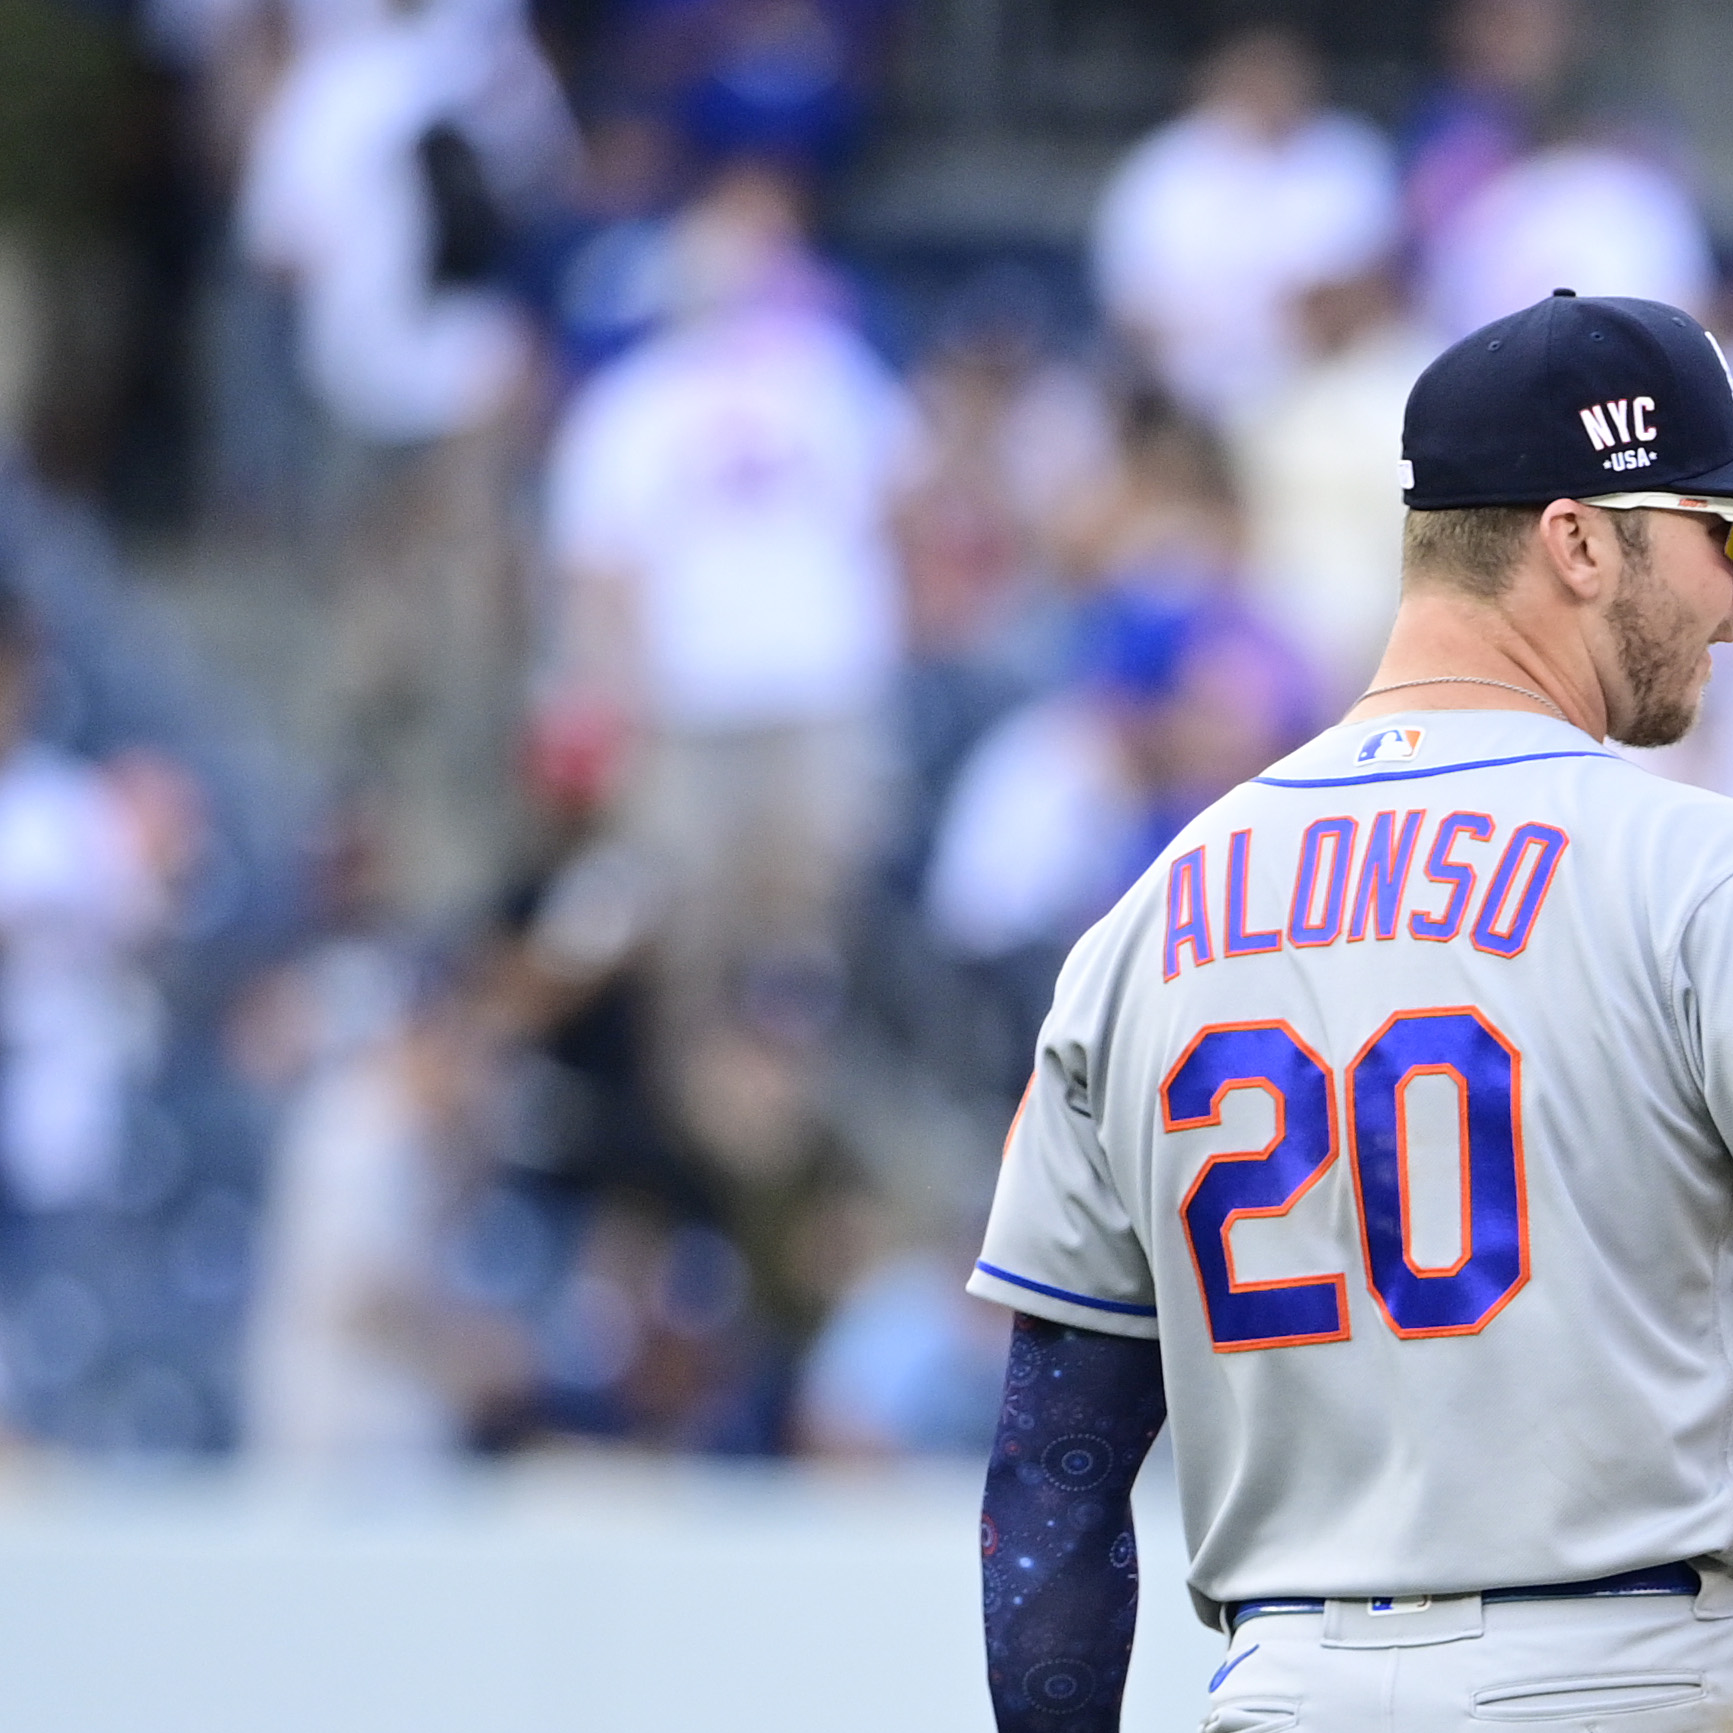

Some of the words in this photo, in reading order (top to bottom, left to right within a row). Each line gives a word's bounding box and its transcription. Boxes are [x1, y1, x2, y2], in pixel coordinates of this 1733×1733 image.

[1580, 397, 1657, 450] NYC
[1613, 449, 1650, 471] USA
[1163, 809, 1569, 983] ALONSO
[1159, 1005, 1530, 1353] 20
